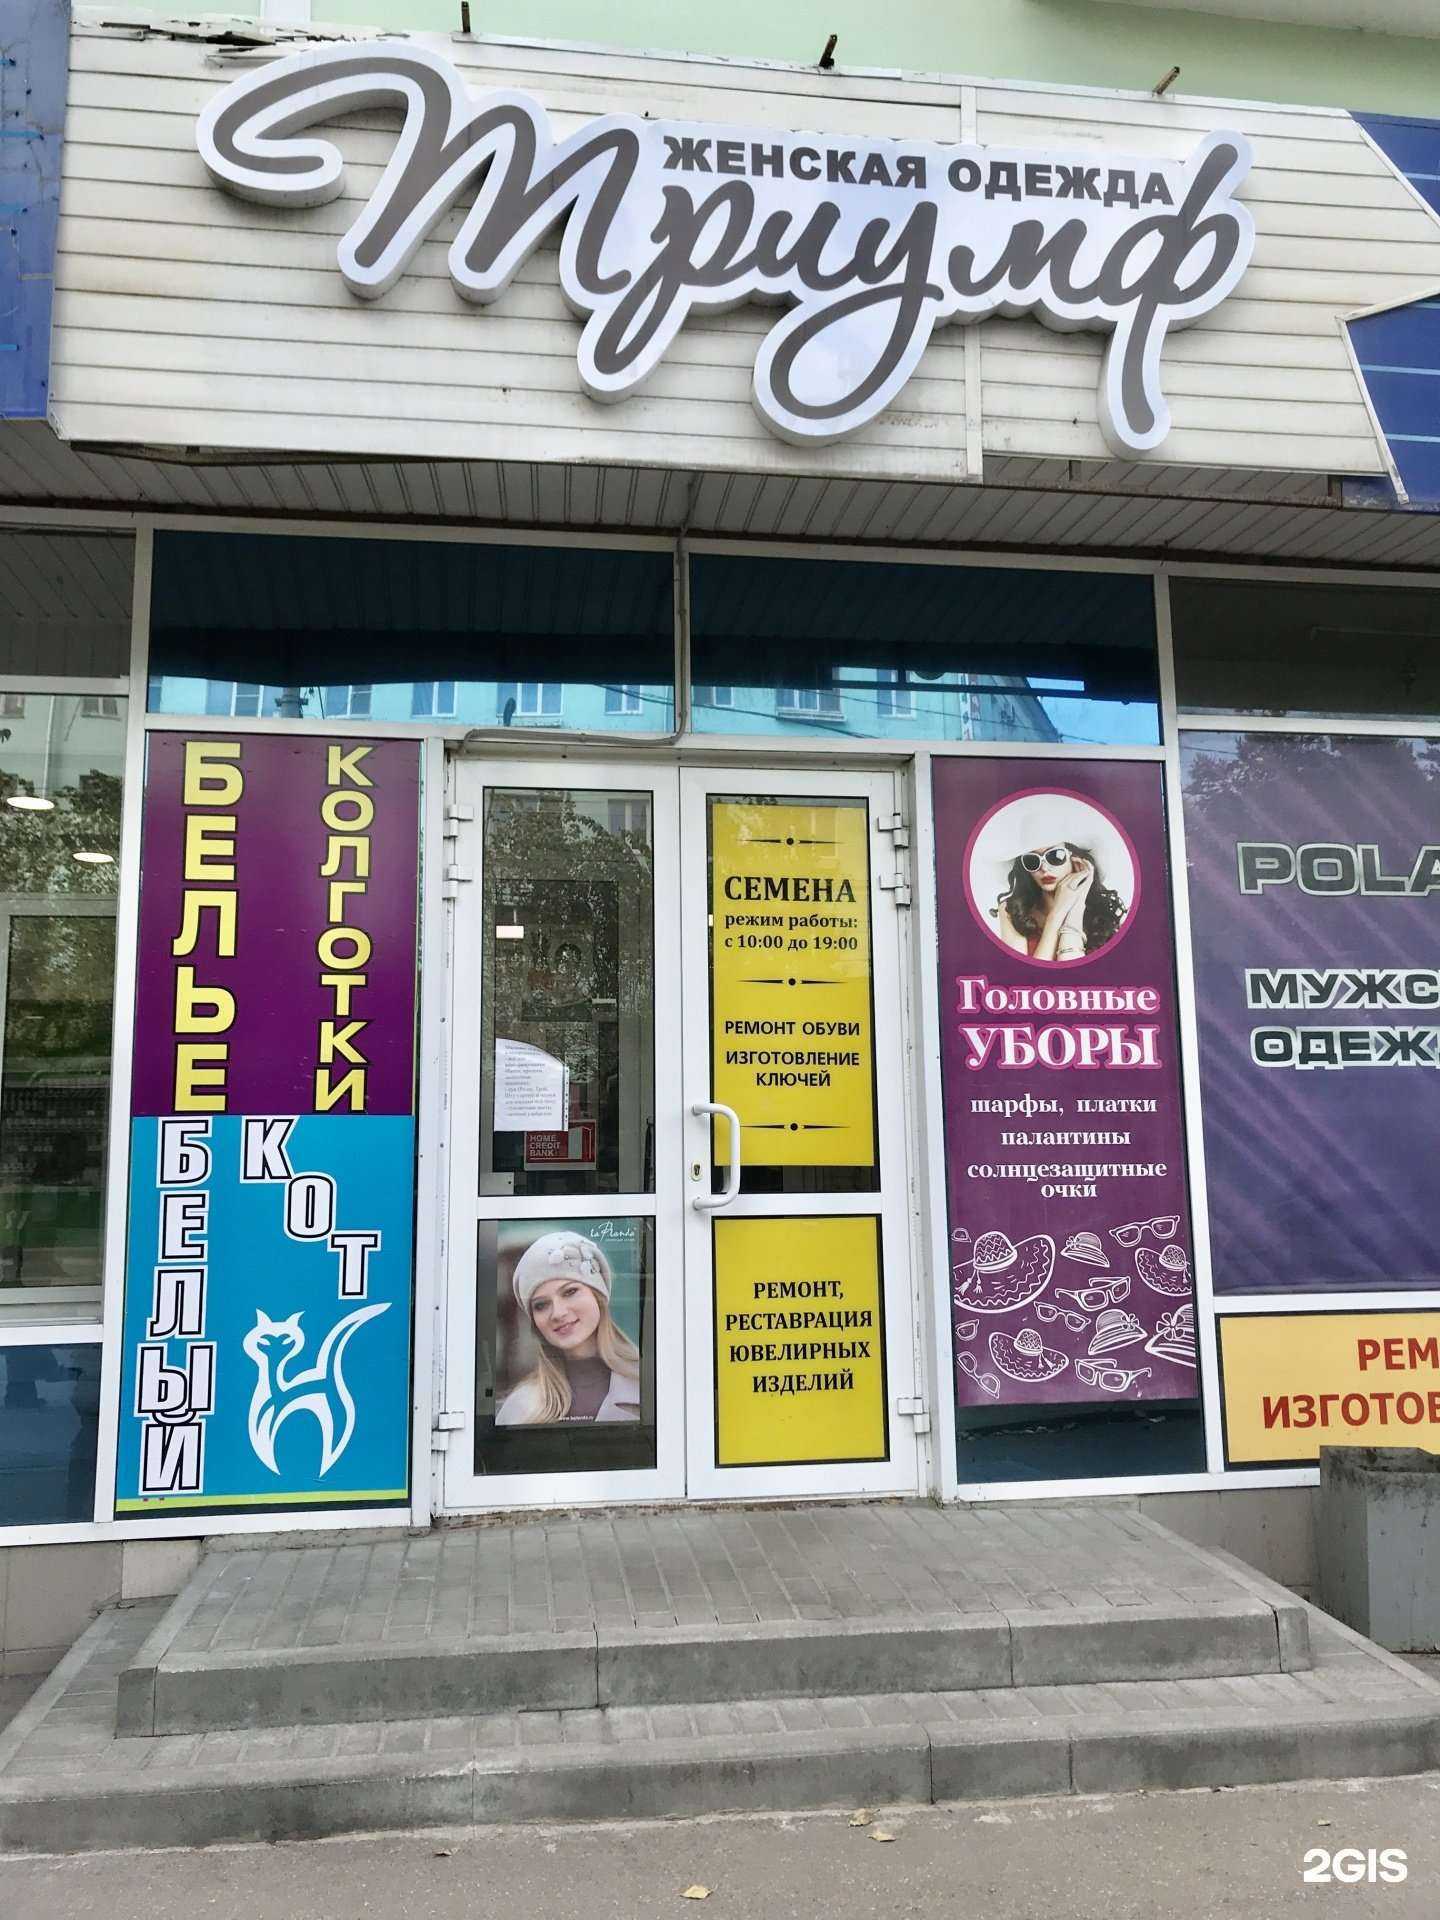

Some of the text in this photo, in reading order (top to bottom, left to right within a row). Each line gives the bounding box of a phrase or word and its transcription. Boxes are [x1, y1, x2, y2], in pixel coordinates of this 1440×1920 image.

[663, 135, 1175, 210] ЖЕНСКАЯ ОДЕЖДА
[724, 876, 856, 902] СЕМЕНА
[171, 740, 245, 1112] БЕЛЬЕ
[313, 744, 375, 1112] КОЛГОТКИ
[725, 914, 858, 928] режим работы:
[724, 935, 858, 951] с 10:00 до 19:00
[957, 977, 1158, 1012] Головные
[725, 1021, 860, 1036] РЕМОНТ ОБУВИ
[960, 1025, 1160, 1068] УБОРЫ
[1251, 1026, 1440, 1069] ОДЕЖ
[726, 1051, 860, 1066] ИЗГОТОВЛЕНИЕ
[756, 1069, 831, 1086] КЛЮЧЕЙ
[970, 1093, 1157, 1118] шарфы, платки
[530, 1134, 557, 1142] HOME
[530, 1142, 561, 1150] CREDIT
[1001, 1130, 1132, 1145] палантины
[967, 1162, 1168, 1182] солнцезащитные
[1041, 1184, 1097, 1198] очки
[241, 1117, 381, 1298] КОТ
[753, 1280, 844, 1299] РЕМОНТ,
[136, 1117, 216, 1494] БЕЛЫЙ
[725, 1310, 872, 1331] РЕСТАВРАЦИЯ
[729, 1341, 871, 1362] ЮВЕЛИРНЫХ
[1357, 1337, 1440, 1371] РЕМ
[752, 1368, 854, 1396] ИЗДЕЛИЙ
